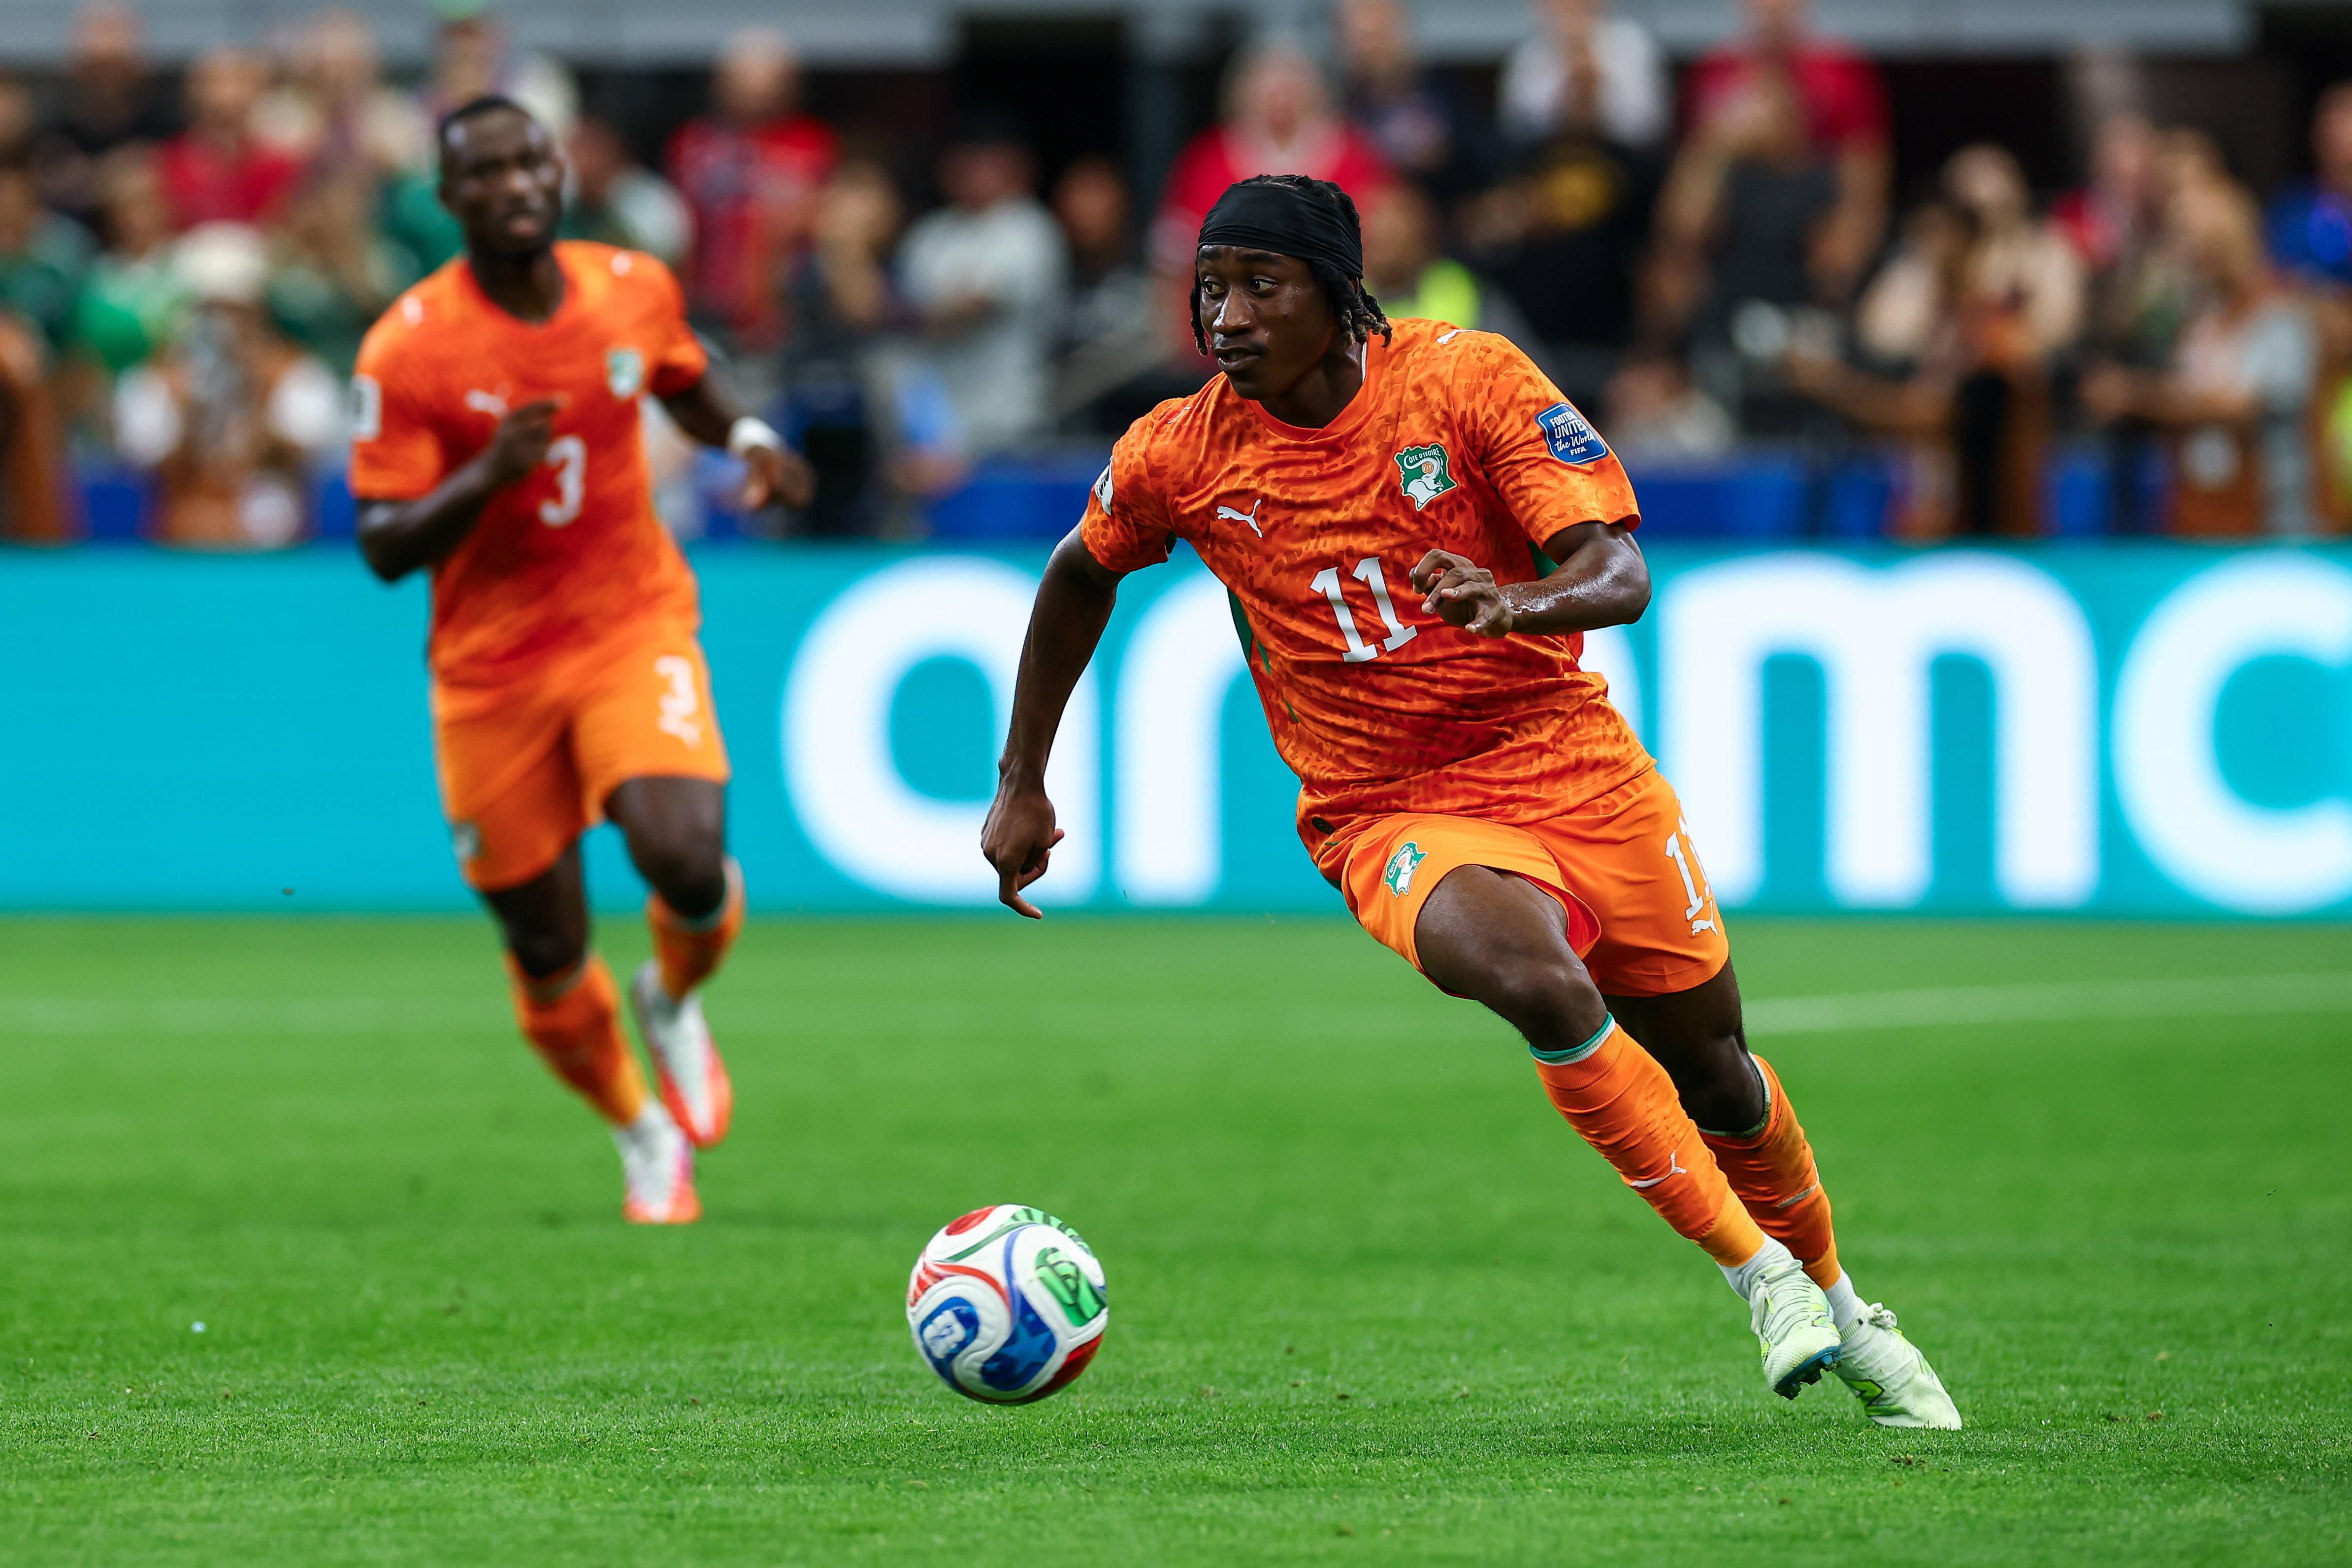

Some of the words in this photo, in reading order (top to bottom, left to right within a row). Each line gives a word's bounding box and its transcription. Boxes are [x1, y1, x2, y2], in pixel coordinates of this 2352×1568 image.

[1554, 419, 1587, 438] UNITES
[1555, 439, 1570, 452] the
[540, 436, 586, 526] 3
[1309, 557, 1417, 662] 11
